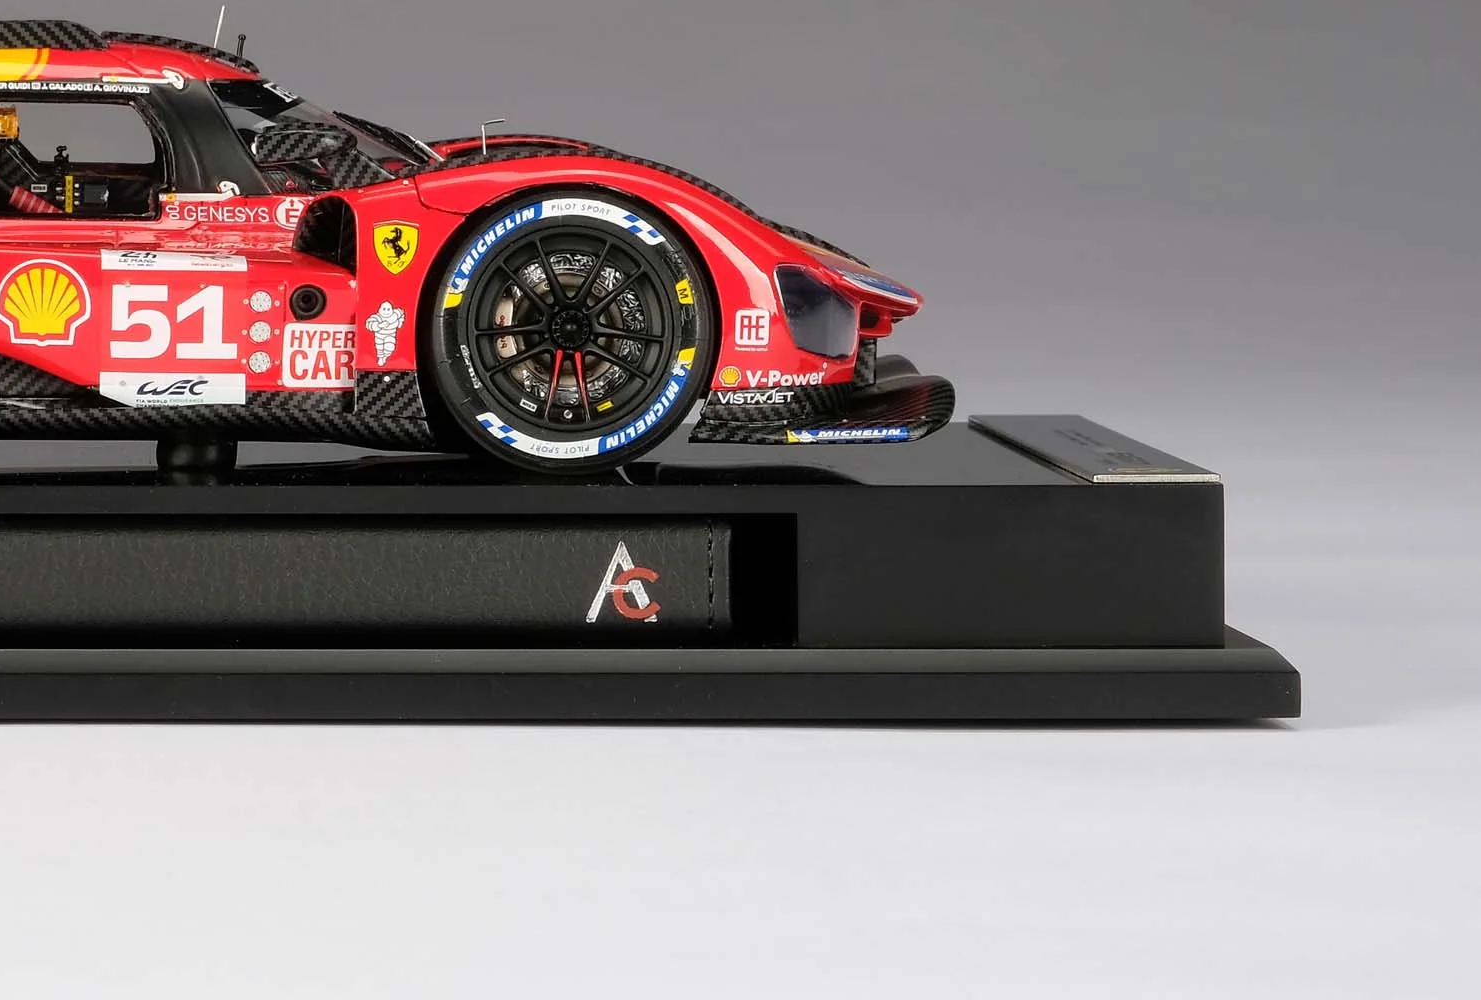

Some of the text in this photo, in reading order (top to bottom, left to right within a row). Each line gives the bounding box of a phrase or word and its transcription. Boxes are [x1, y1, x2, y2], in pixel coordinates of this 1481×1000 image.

[183, 205, 270, 222] GENESYS
[550, 203, 611, 216] PILOT SPORT
[460, 207, 536, 276] MICHELIN
[109, 284, 239, 360] 51
[290, 329, 356, 349] HYPER
[289, 349, 355, 381] CAR
[136, 379, 209, 396] WEC
[746, 368, 825, 388] V-Power
[606, 378, 680, 449] MICHELIN
[817, 428, 902, 438] MICHELIN
